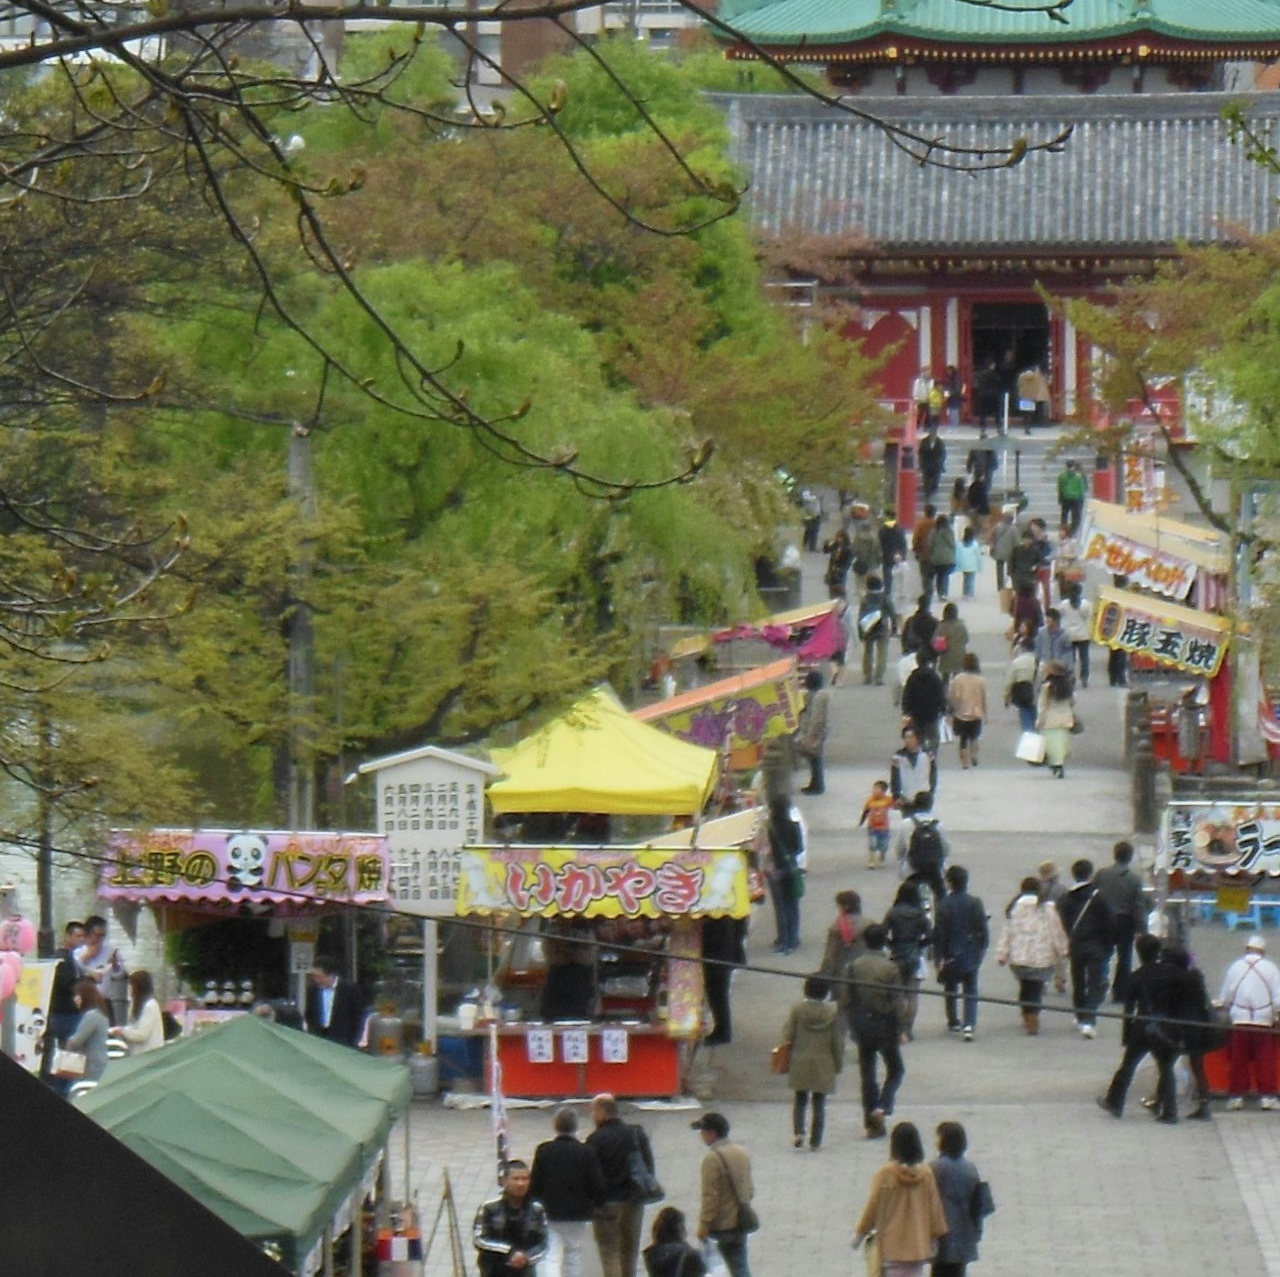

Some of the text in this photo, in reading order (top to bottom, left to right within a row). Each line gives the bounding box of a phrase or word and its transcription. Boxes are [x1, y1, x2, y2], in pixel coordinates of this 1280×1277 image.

[109, 849, 217, 888] 上野の
[505, 861, 705, 914] いかやき
